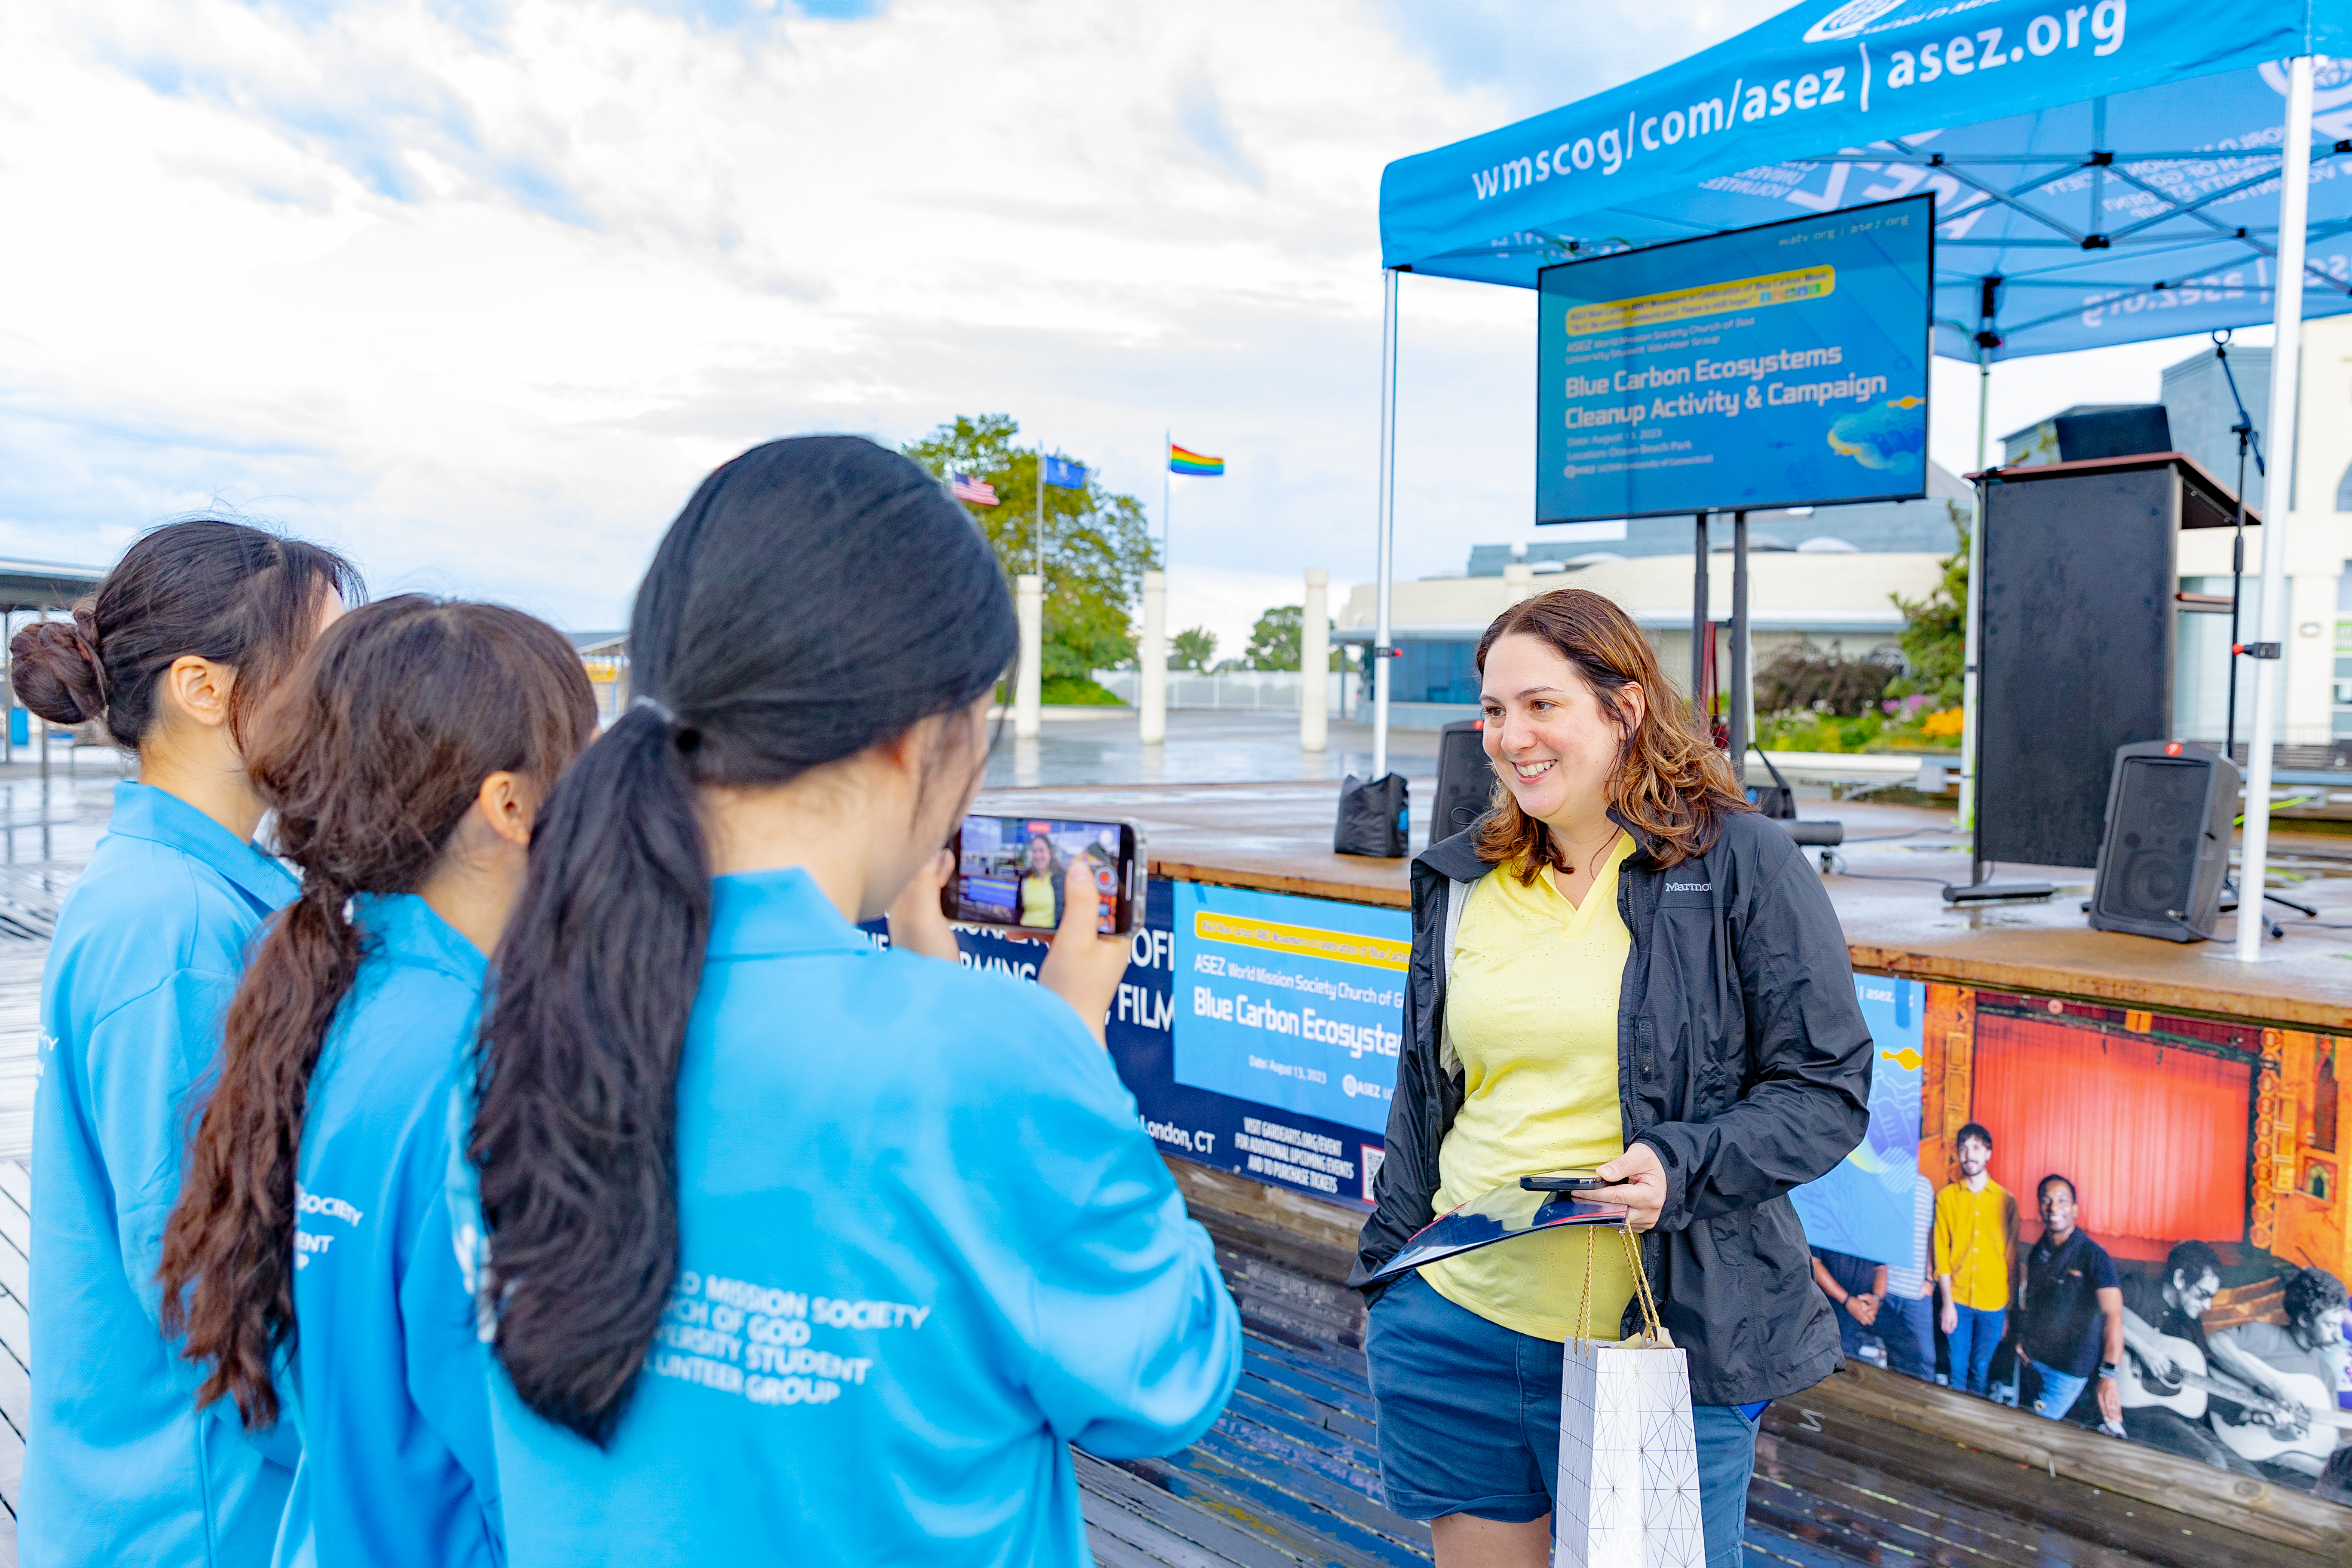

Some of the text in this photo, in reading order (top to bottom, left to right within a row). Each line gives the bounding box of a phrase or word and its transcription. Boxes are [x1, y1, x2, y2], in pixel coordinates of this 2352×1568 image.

[1472, 66, 1847, 200] wmscog/com/asez
[1887, 0, 2127, 89] asez.org
[1565, 346, 1842, 399] Blue Carbon Ecosystems
[1565, 371, 1887, 429] Cleanup Activity & Campaign
[1194, 953, 1226, 977] ASEZ
[1227, 962, 1255, 982] World
[1256, 966, 1294, 990] Mission
[1295, 974, 1337, 1002] Society
[1337, 981, 1377, 1004] Church
[1378, 992, 1393, 1007] of
[1193, 986, 1403, 1059] Blue Carbon Ecosyste
[1194, 1130, 1216, 1155] CT
[1243, 1116, 1262, 1136] VISIT
[1234, 1131, 1355, 1180] FOR ADDITIONAL UPCOMING EVENTS
[1247, 1154, 1338, 1194] AND TO PURCHASE TICKETS
[705, 1274, 808, 1319] MISSION
[811, 1296, 931, 1330] SOCIETY
[746, 1314, 812, 1347] GOD
[745, 1341, 873, 1386] STUDENT
[745, 1373, 841, 1406] GROUP
